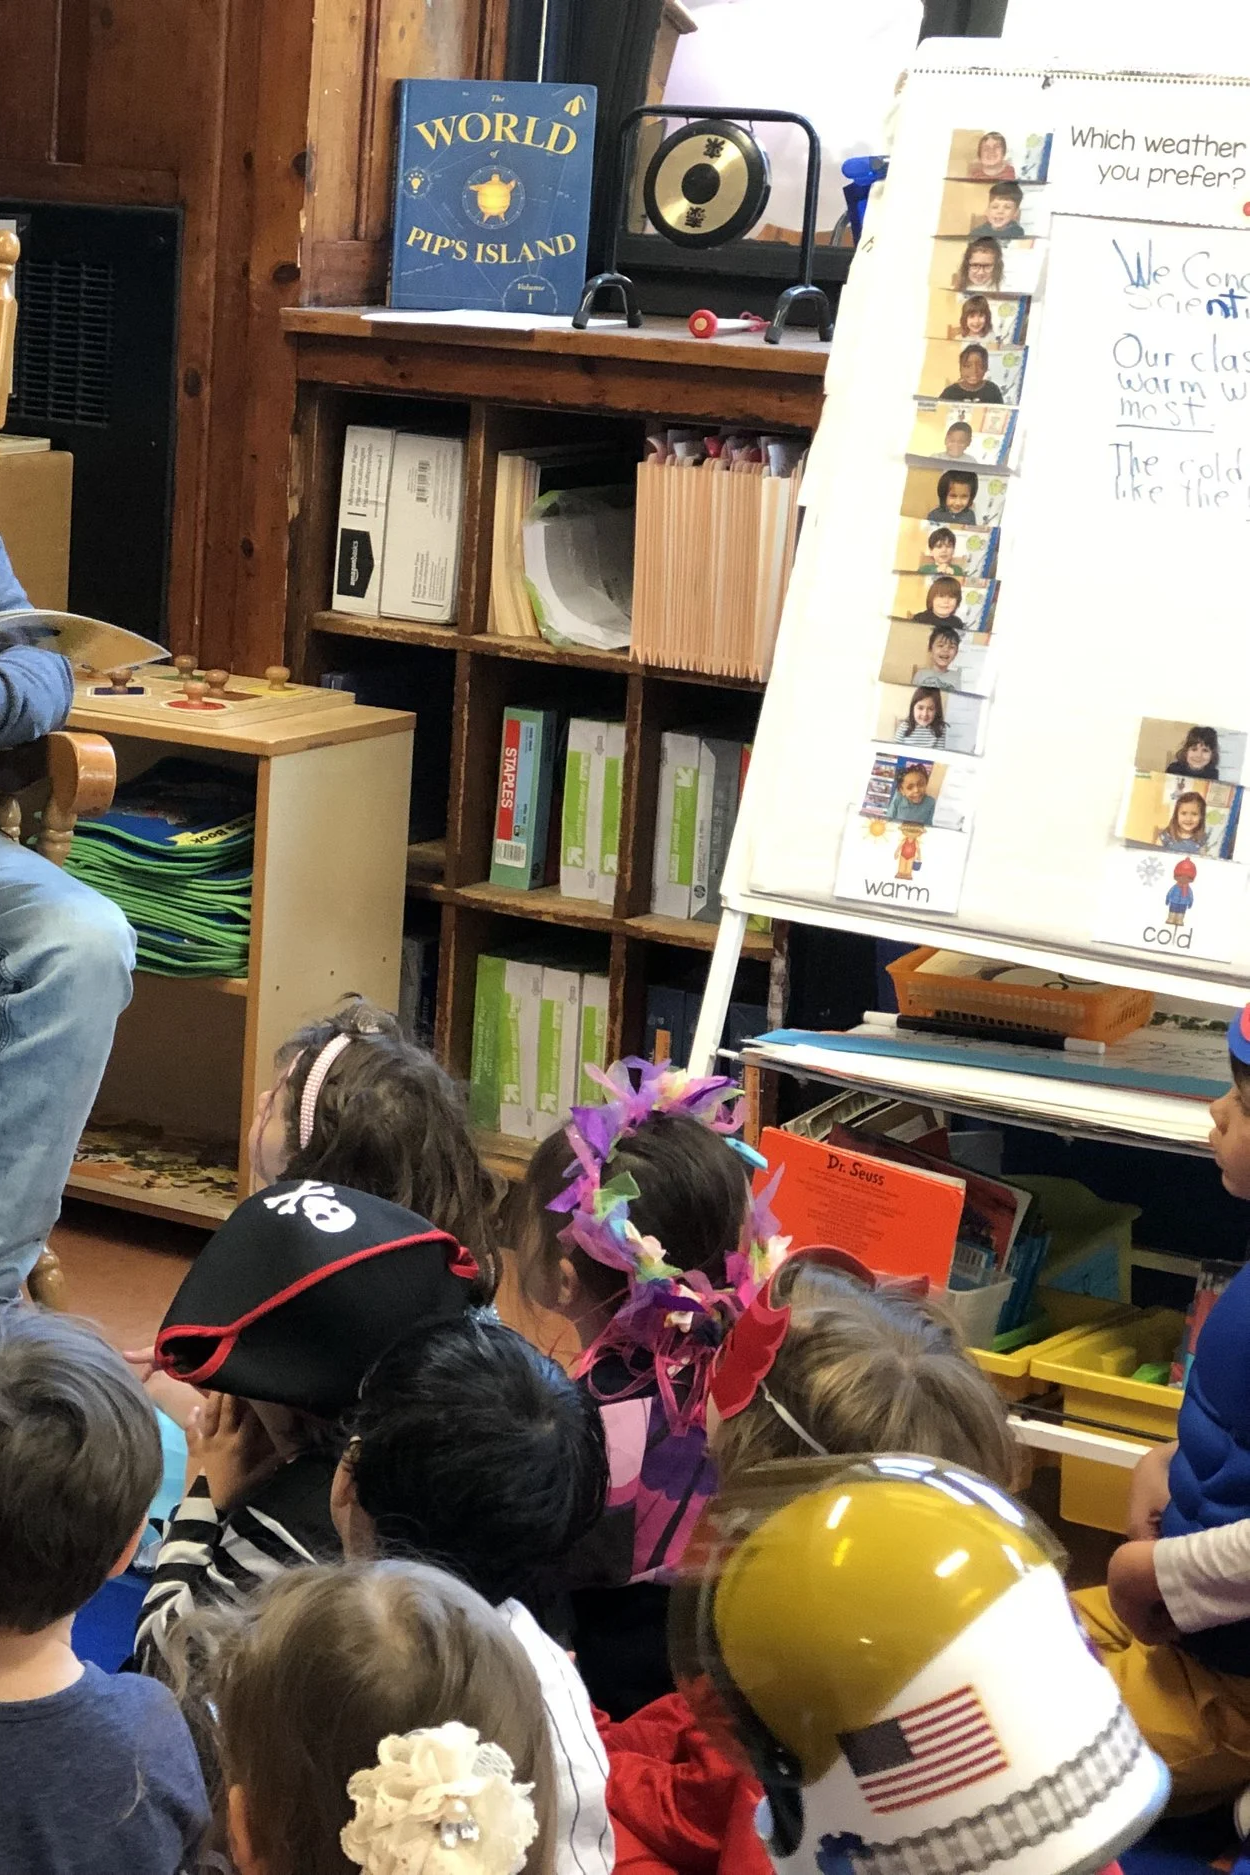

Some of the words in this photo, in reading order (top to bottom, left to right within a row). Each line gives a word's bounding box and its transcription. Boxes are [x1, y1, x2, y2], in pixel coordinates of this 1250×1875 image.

[413, 112, 578, 155] WORLD
[1071, 125, 1135, 151] Which
[1143, 133, 1246, 158] weather
[490, 149, 499, 159] of
[1097, 164, 1140, 185] you
[1147, 164, 1246, 189] prefer?
[406, 226, 469, 261] PIP'S
[474, 233, 577, 264] ISLAND
[1112, 238, 1170, 288] We
[1113, 333, 1175, 369] Our
[1117, 372, 1206, 400] warm
[1108, 441, 1159, 477] The
[1180, 478, 1230, 508] the
[501, 747, 518, 809] STAPLES
[190, 829, 228, 844] Book
[864, 879, 930, 903] warm
[1143, 924, 1193, 950] cold
[827, 1154, 846, 1174] Dr.
[850, 1162, 885, 1187] Seuss
